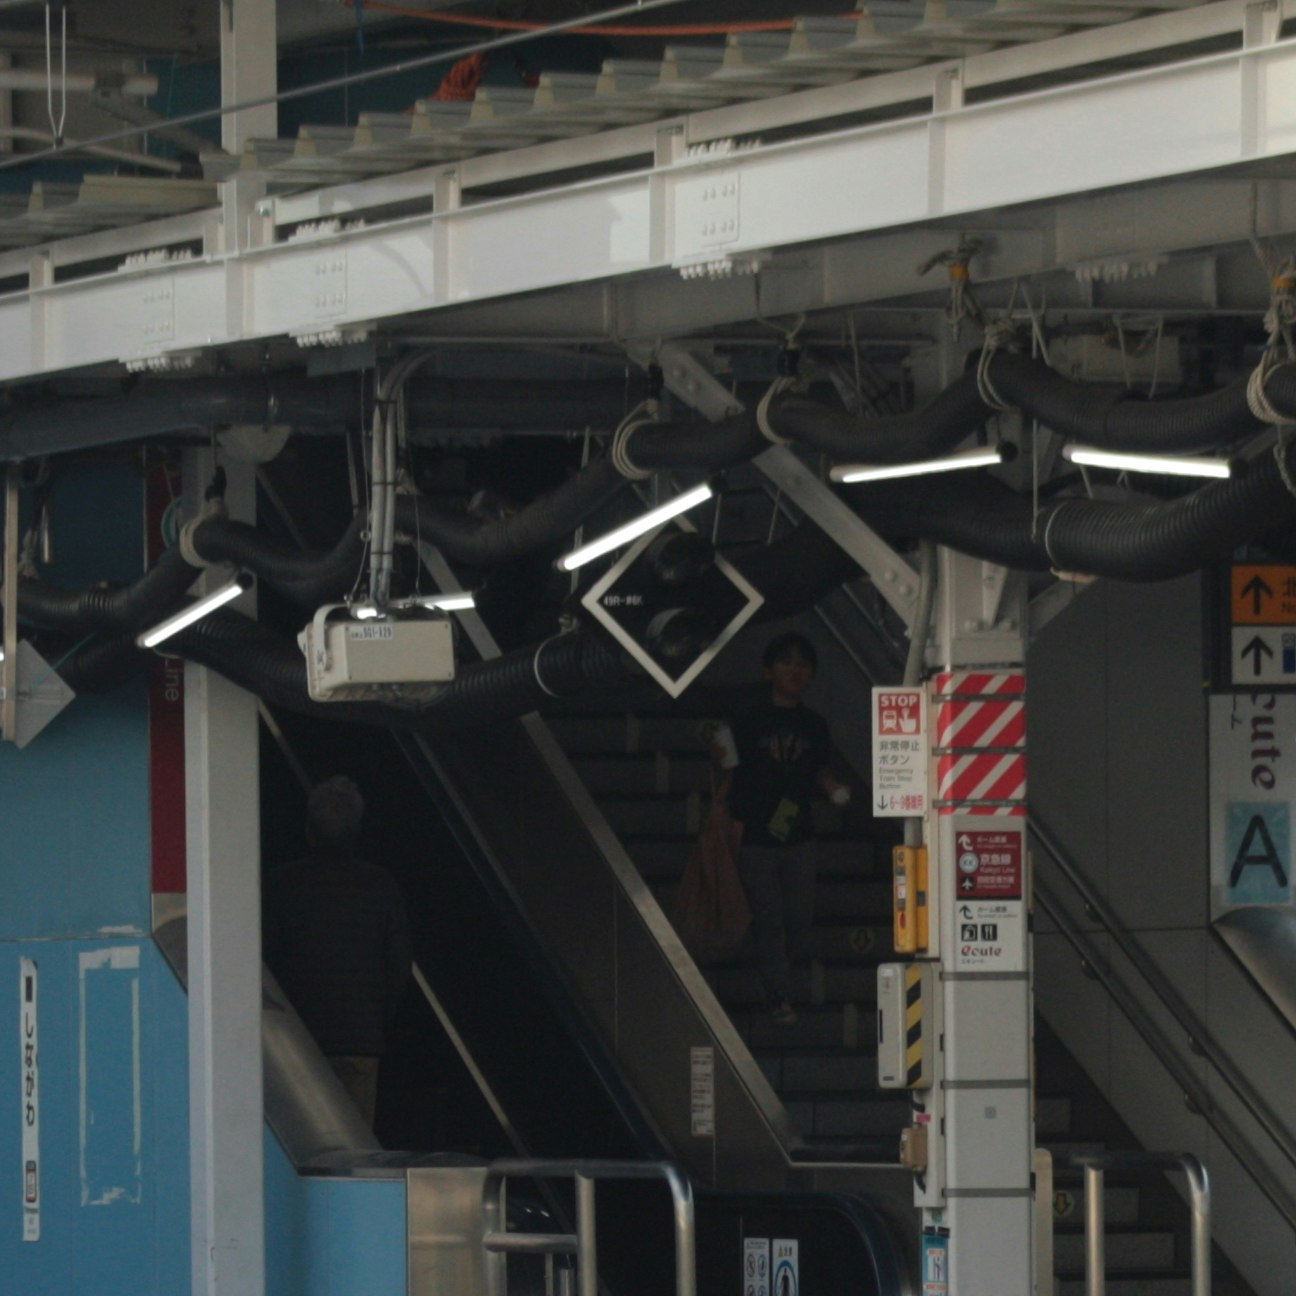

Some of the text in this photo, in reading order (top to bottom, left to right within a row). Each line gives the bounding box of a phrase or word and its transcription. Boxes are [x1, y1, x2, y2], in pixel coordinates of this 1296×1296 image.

[880, 695, 918, 707] STOP
[879, 741, 920, 752] 非常停止
[879, 755, 910, 766] ボタン
[1230, 815, 1288, 888] A
[961, 945, 1002, 957] ecute
[25, 1011, 36, 1127] しながわ
